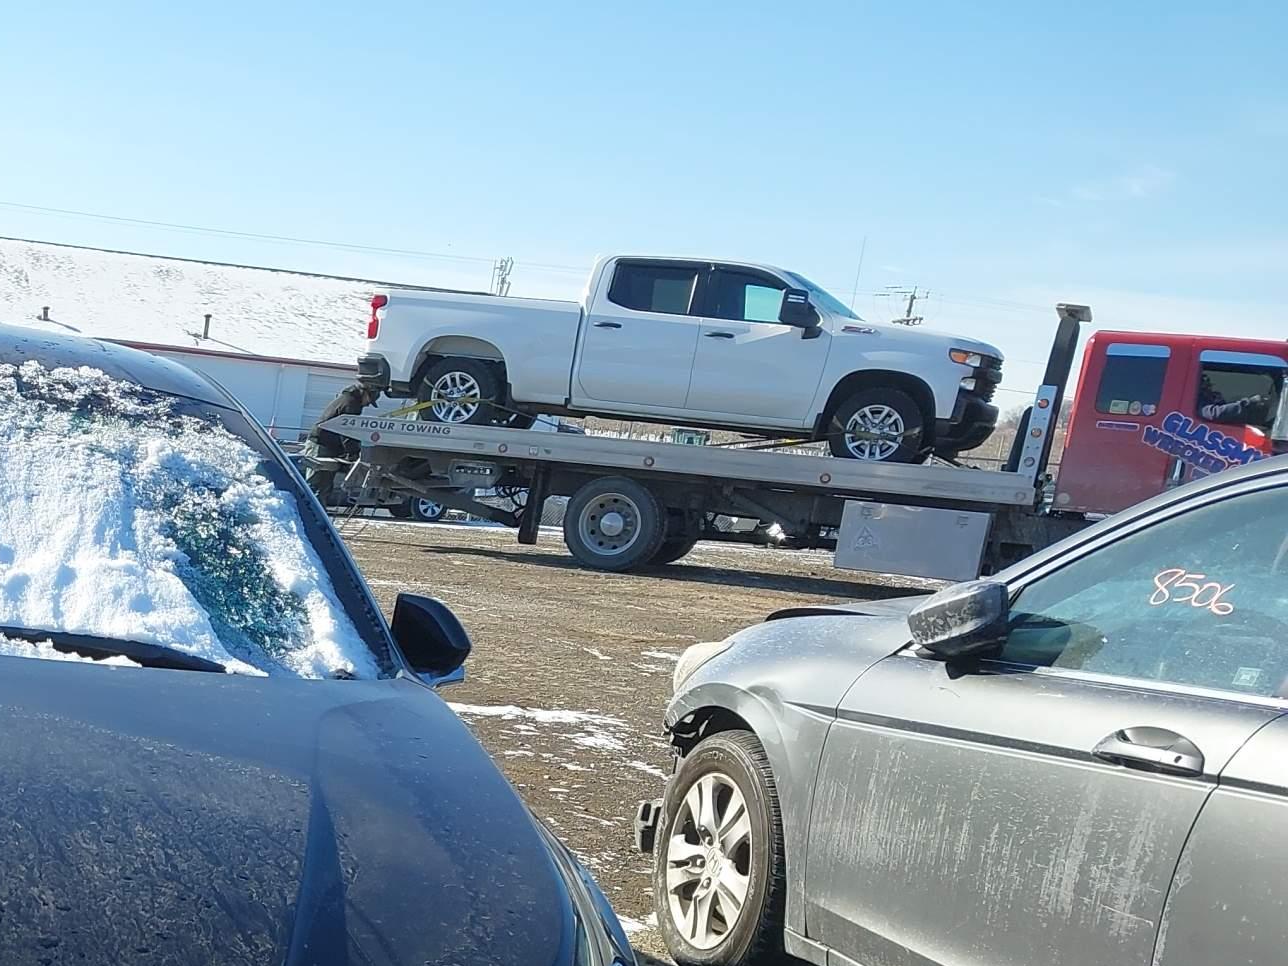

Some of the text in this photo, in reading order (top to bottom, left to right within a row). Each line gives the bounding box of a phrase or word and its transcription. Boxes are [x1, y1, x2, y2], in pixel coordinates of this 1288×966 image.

[341, 418, 451, 435] 24 HOUR TOWING
[1149, 568, 1236, 615] 8506
